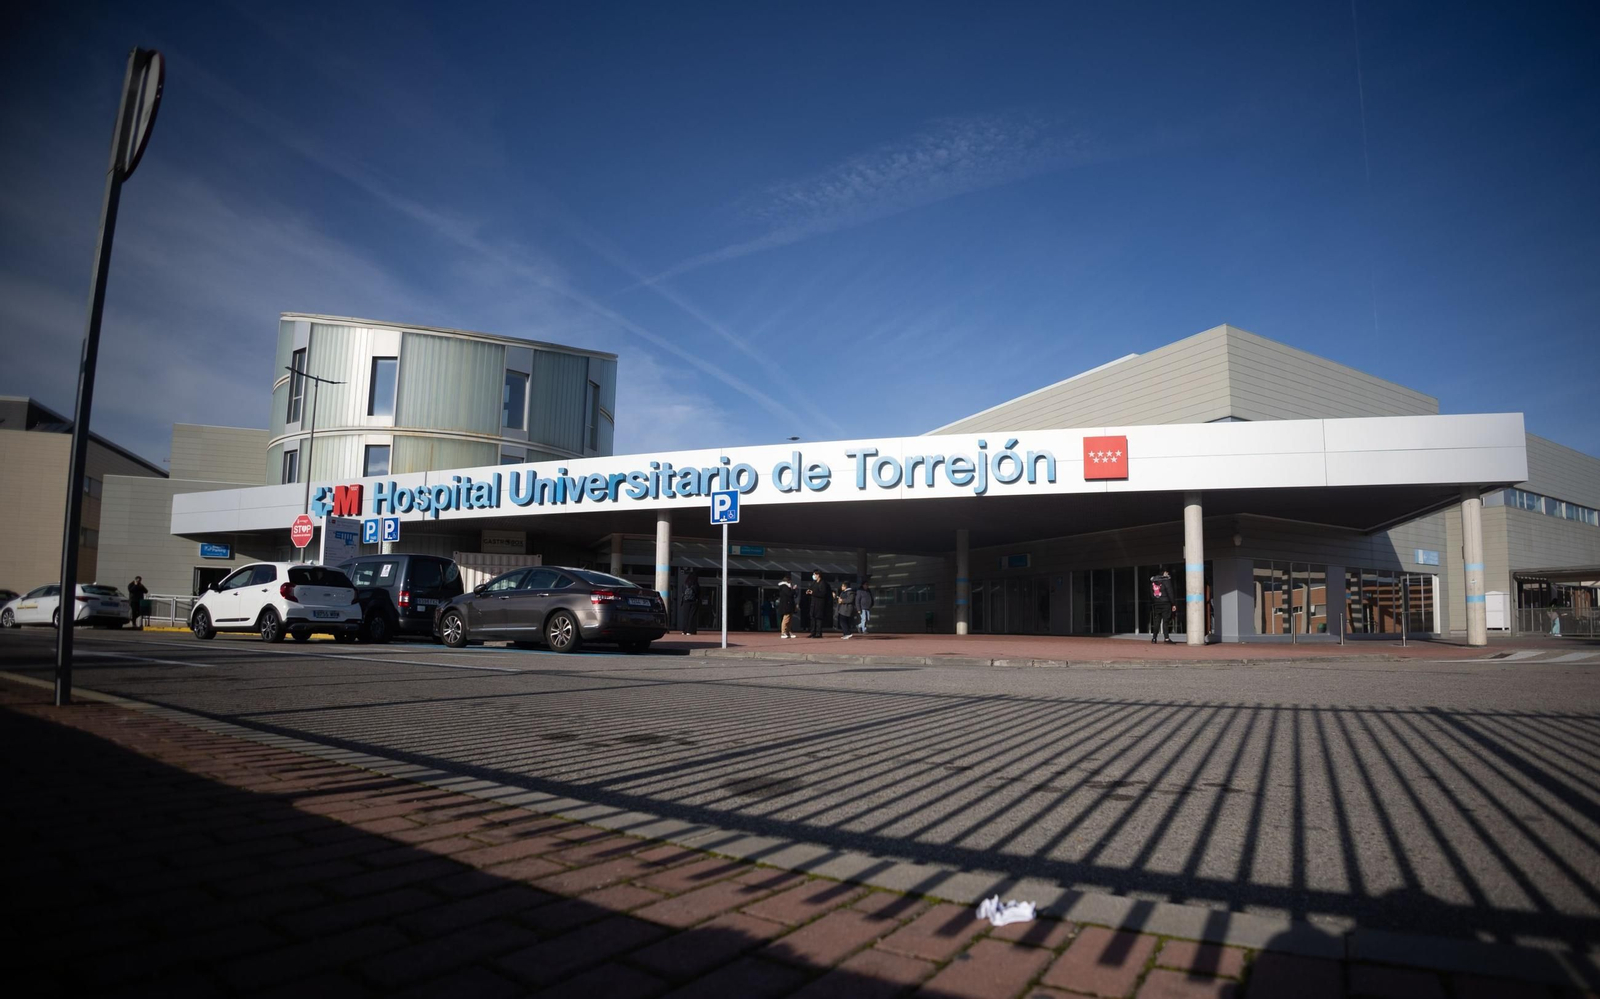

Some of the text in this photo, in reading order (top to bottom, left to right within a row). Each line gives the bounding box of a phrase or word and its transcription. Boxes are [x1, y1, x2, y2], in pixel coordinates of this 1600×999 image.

[372, 439, 1057, 519] Hospital Universitario de Torrejón
[713, 494, 732, 520] P
[366, 521, 376, 540] P
[384, 520, 395, 539] P
